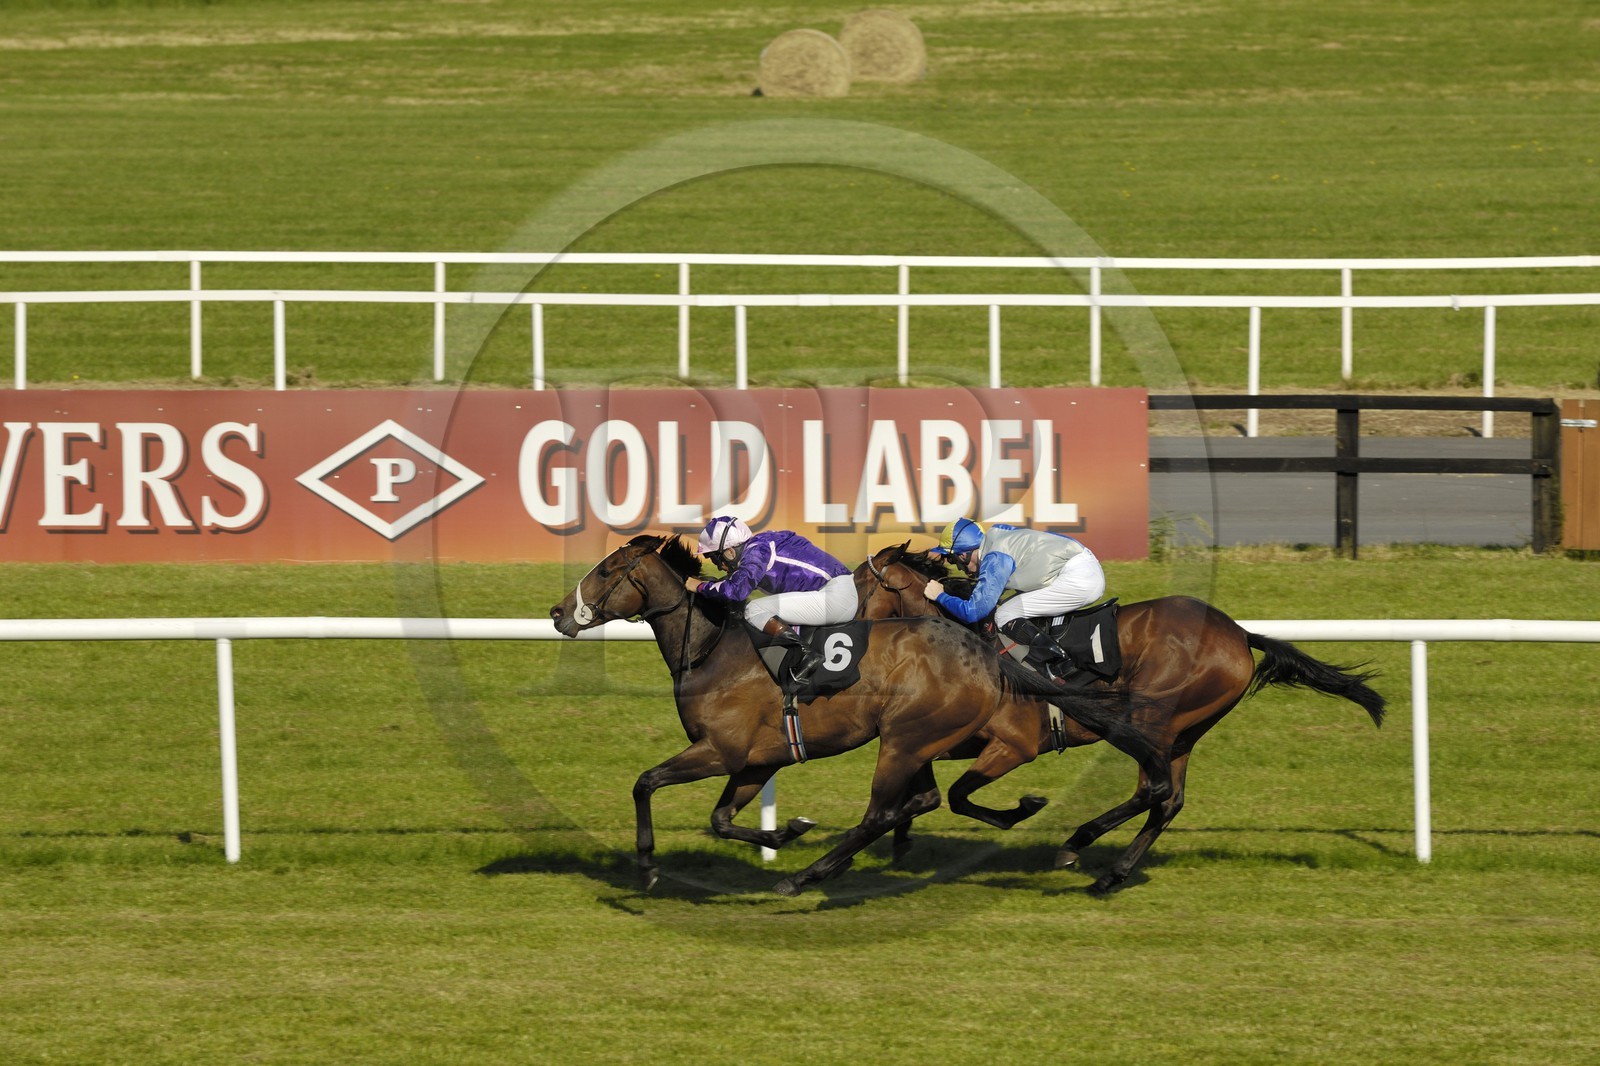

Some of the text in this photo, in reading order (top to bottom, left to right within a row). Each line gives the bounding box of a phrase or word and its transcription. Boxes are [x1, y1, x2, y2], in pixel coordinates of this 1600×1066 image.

[369, 457, 416, 502] P
[518, 418, 772, 526] GOLD
[803, 418, 1079, 523] LABEL
[822, 632, 855, 672] 6
[1090, 623, 1105, 664] 1
